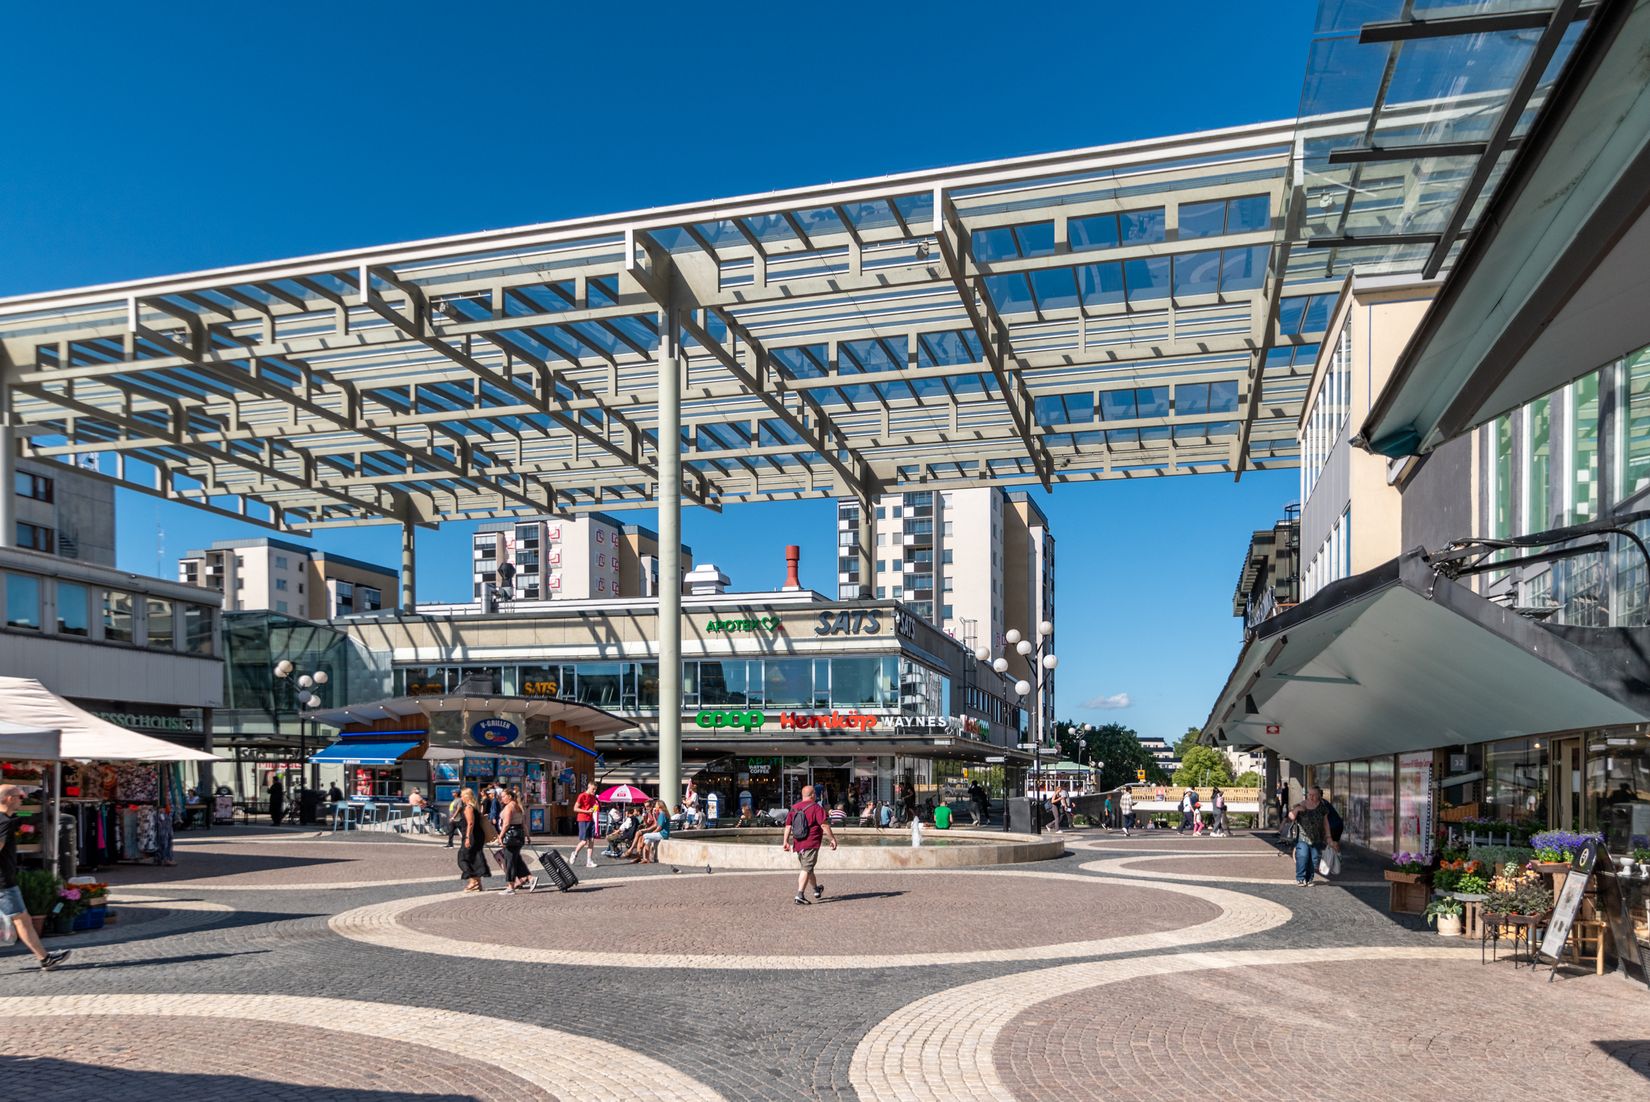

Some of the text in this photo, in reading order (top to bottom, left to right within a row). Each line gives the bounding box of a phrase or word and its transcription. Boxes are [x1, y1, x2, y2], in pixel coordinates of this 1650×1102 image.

[705, 616, 759, 633] APOTEK
[815, 609, 883, 636] SATS
[900, 611, 916, 641] SATS
[524, 682, 557, 695] SATS
[695, 710, 765, 733] coop
[780, 710, 877, 733] Hemköp
[881, 716, 947, 727] WAYNES
